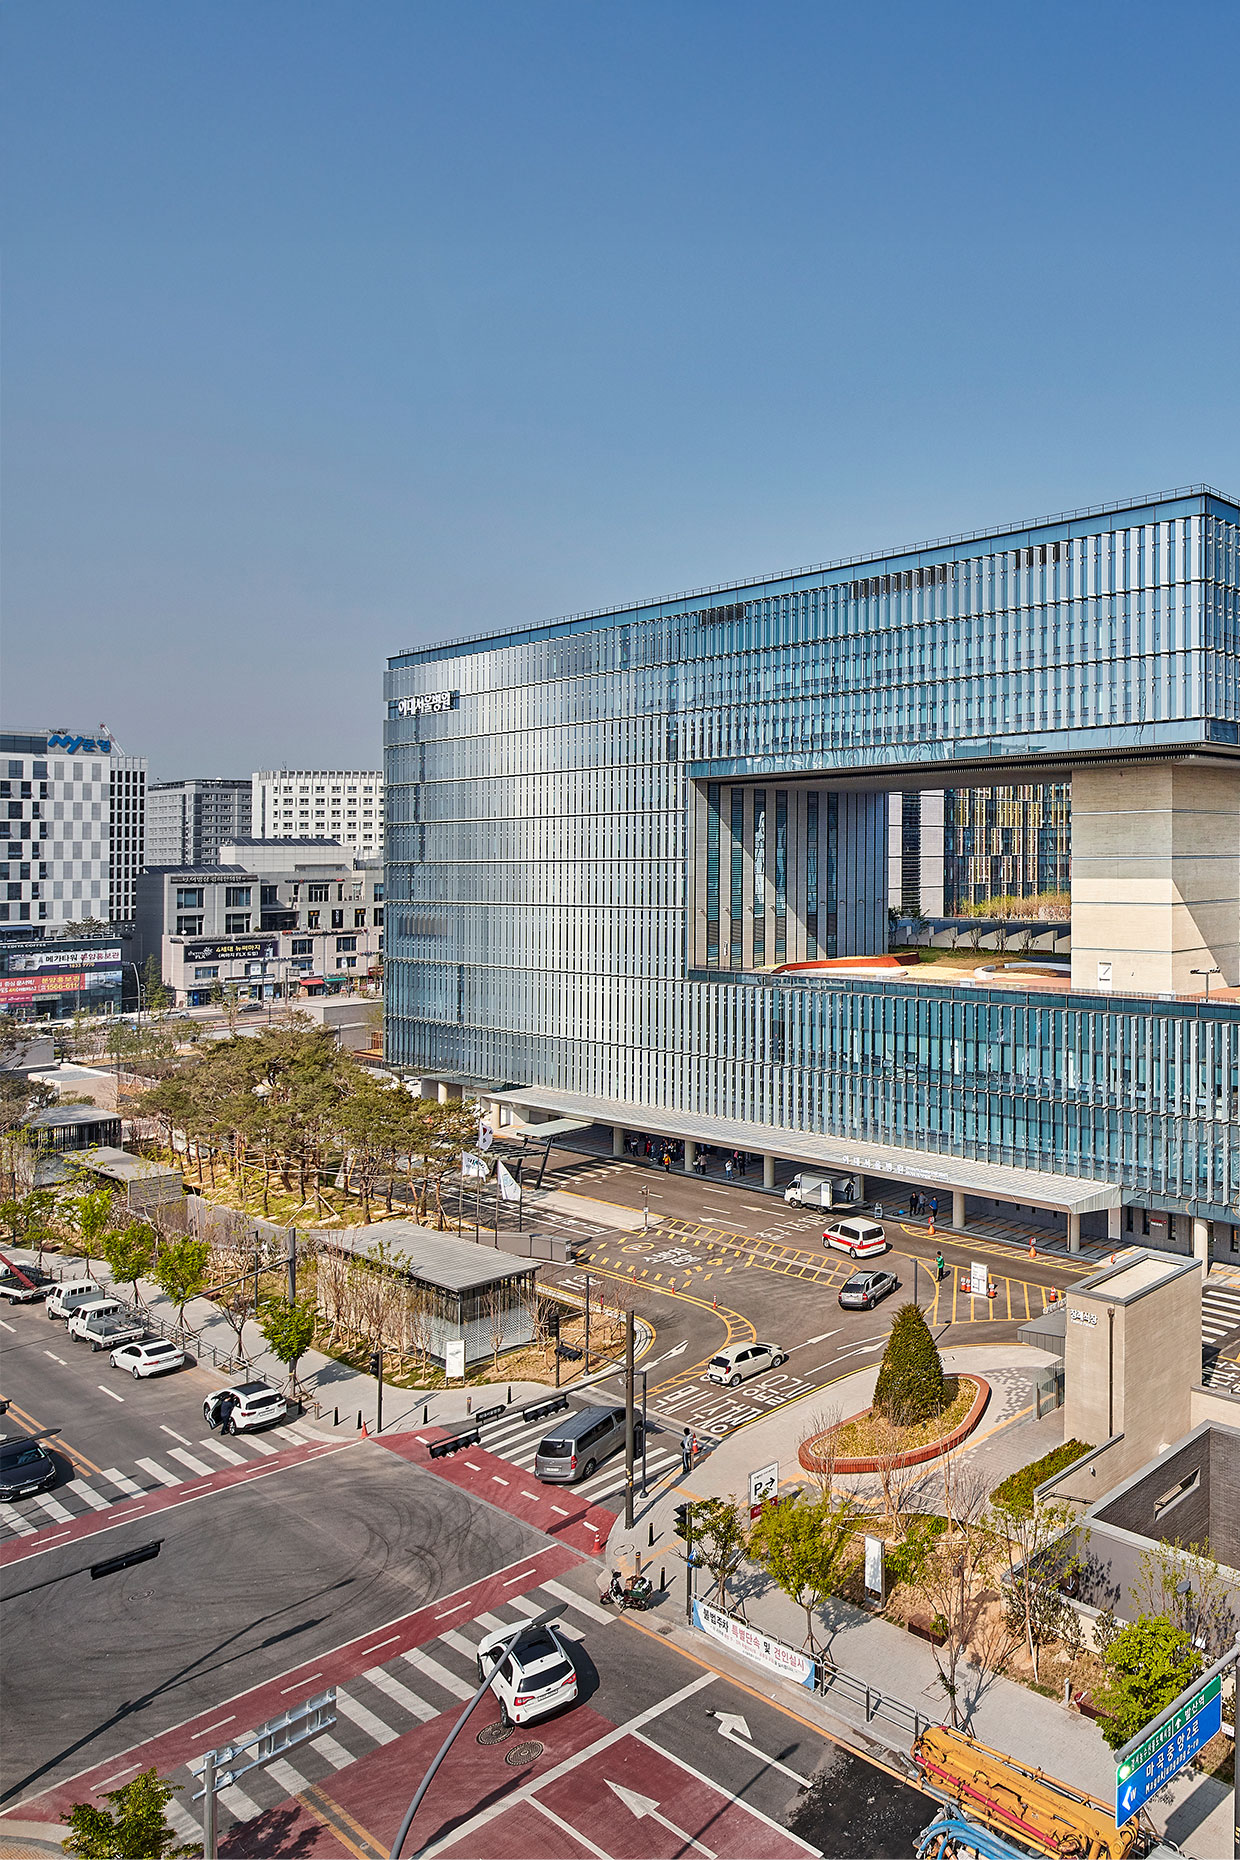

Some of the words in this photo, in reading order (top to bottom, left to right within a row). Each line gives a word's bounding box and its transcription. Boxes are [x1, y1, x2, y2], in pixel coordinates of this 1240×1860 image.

[398, 692, 450, 716] 이대서울병원
[45, 954, 79, 963] 메가타워
[754, 1482, 763, 1496] P
[703, 1608, 729, 1633] 불법주차
[731, 1624, 761, 1650] 특별단속
[763, 1641, 771, 1655] 및
[774, 1646, 805, 1672] 견인실시
[1184, 1695, 1205, 1721] 발산역
[1145, 1720, 1200, 1777] 마곡중앙2로
[1186, 1738, 1199, 1756] 2-ro
[1130, 1786, 1137, 1802] W
